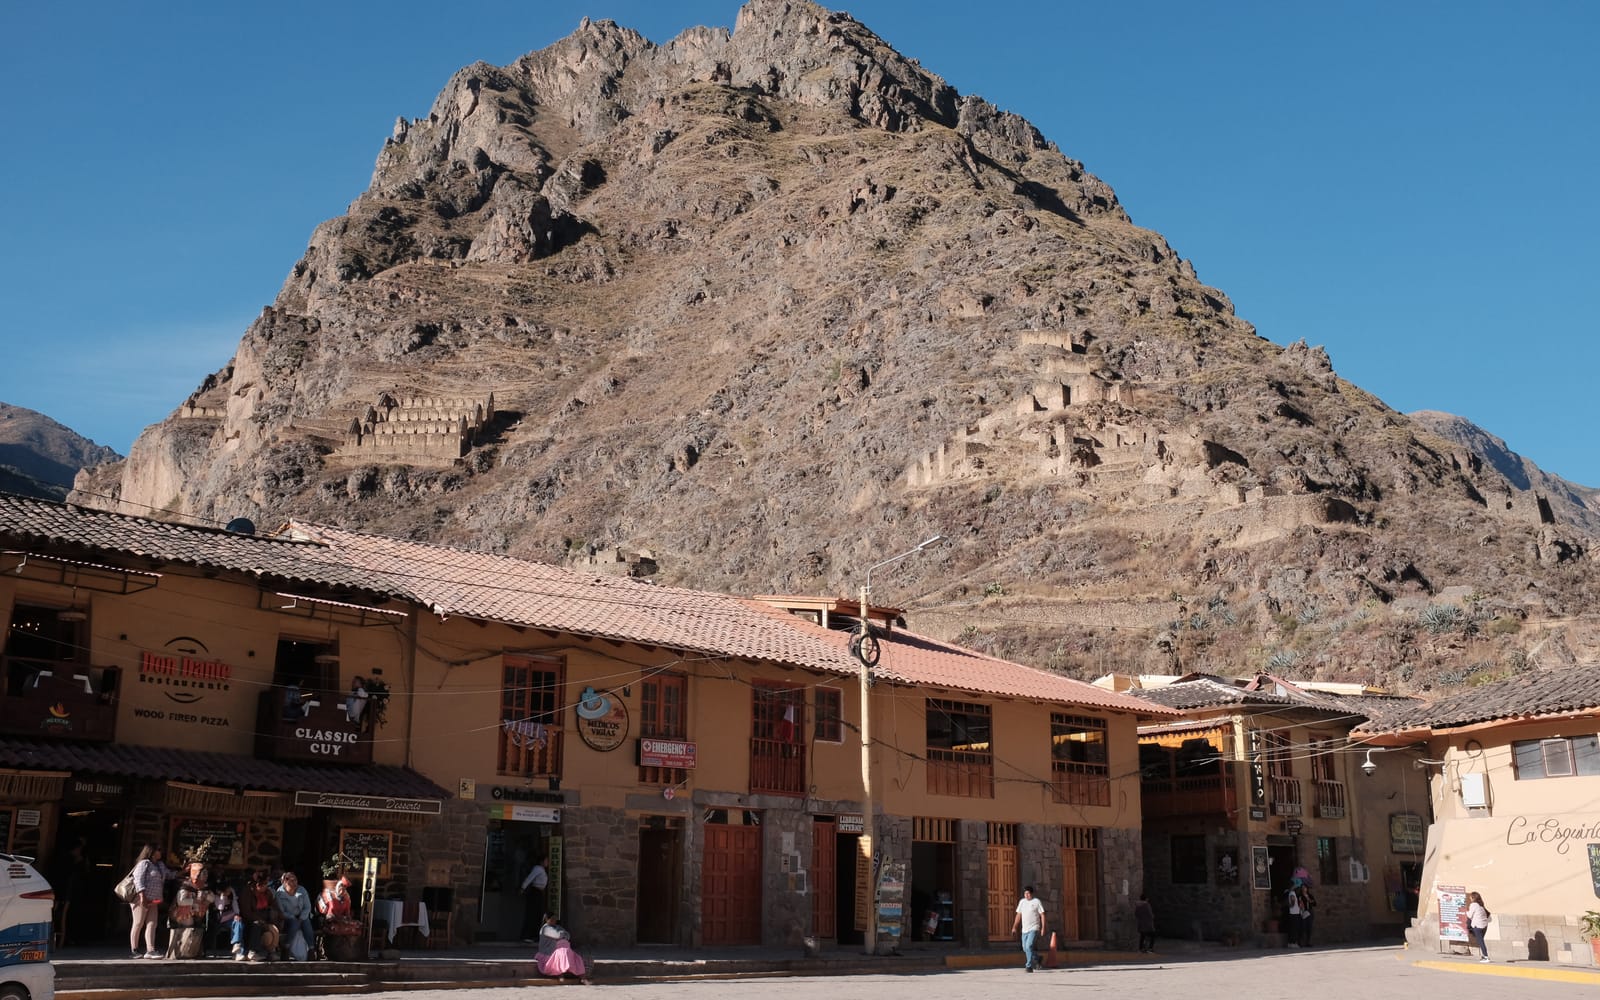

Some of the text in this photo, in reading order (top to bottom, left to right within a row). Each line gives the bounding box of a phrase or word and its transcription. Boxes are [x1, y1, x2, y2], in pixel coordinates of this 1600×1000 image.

[141, 651, 232, 681] Don Dante
[140, 674, 229, 690] Restaurante
[134, 708, 230, 726] WOOD FIRED PIZZA
[295, 728, 358, 744] CLASSIC
[310, 743, 342, 756] CUY
[652, 741, 687, 755] EMERGENCY
[75, 782, 93, 793] Don
[317, 793, 421, 811] Empanadas Desserts
[1507, 816, 1537, 846] La
